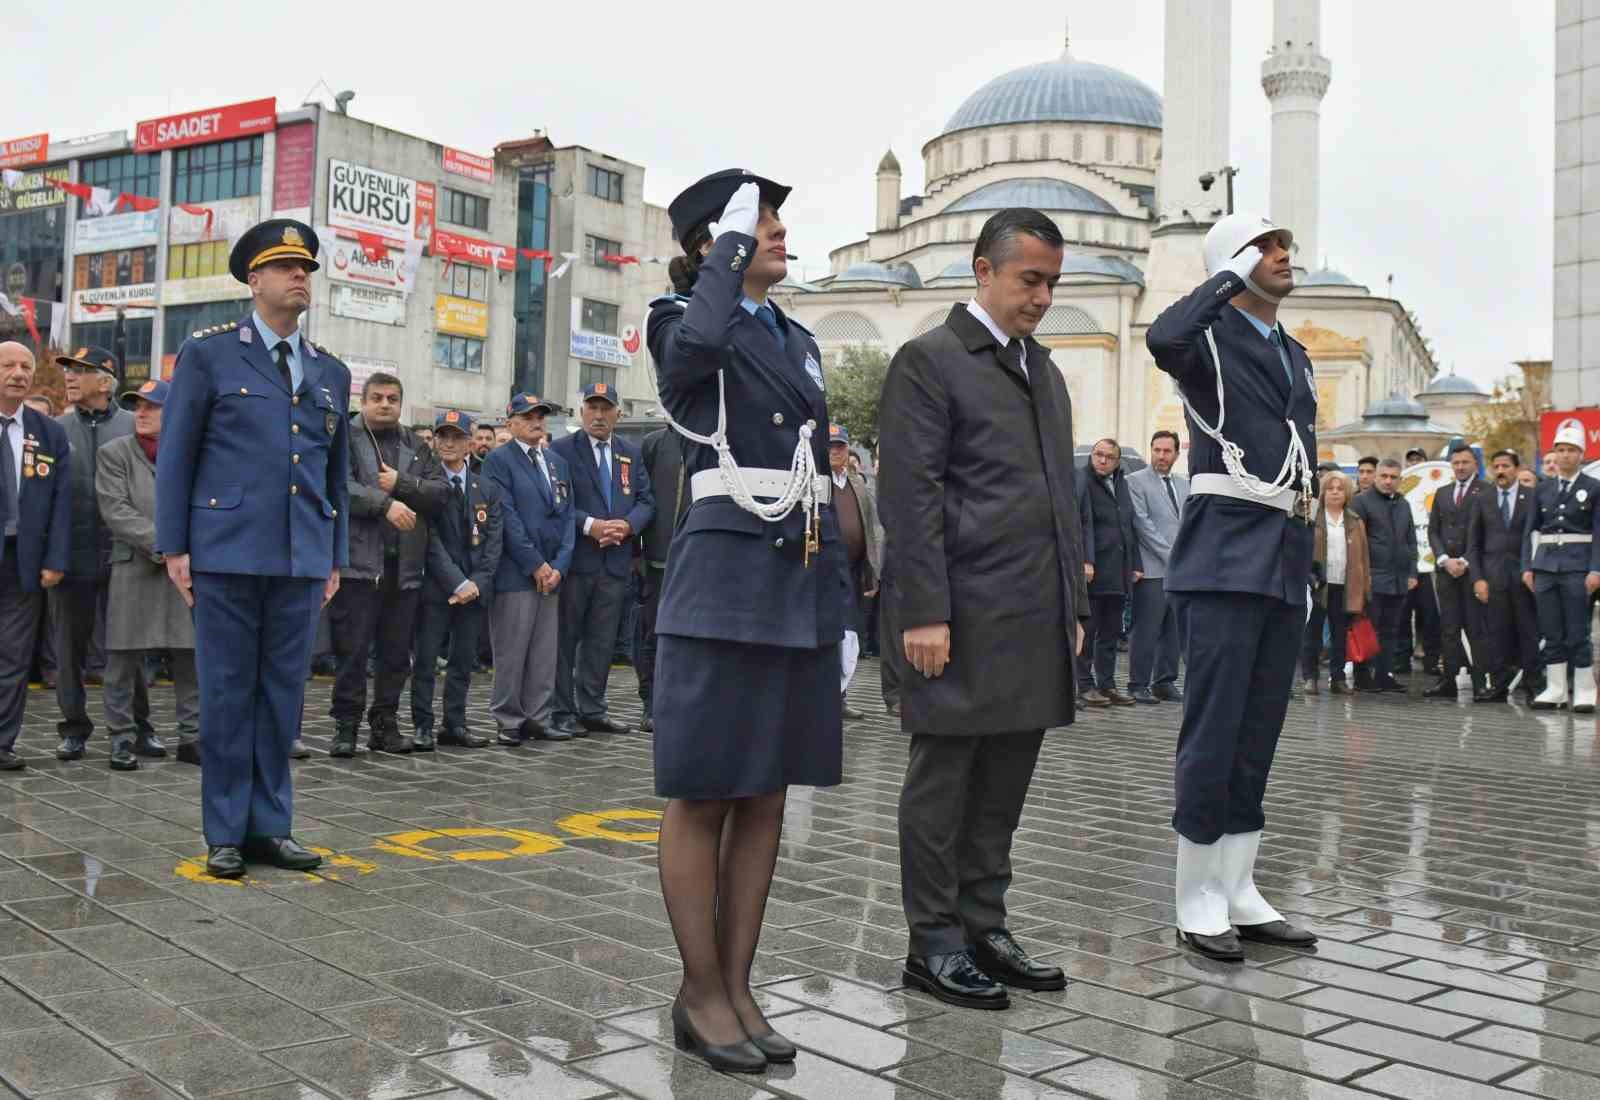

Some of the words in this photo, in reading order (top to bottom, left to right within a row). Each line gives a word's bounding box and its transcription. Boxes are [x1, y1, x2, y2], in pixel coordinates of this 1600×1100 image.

[157, 113, 222, 142] SAADET
[334, 161, 409, 200] GÜVENLİK
[333, 184, 410, 225] KURSU
[351, 248, 394, 271] Alpen
